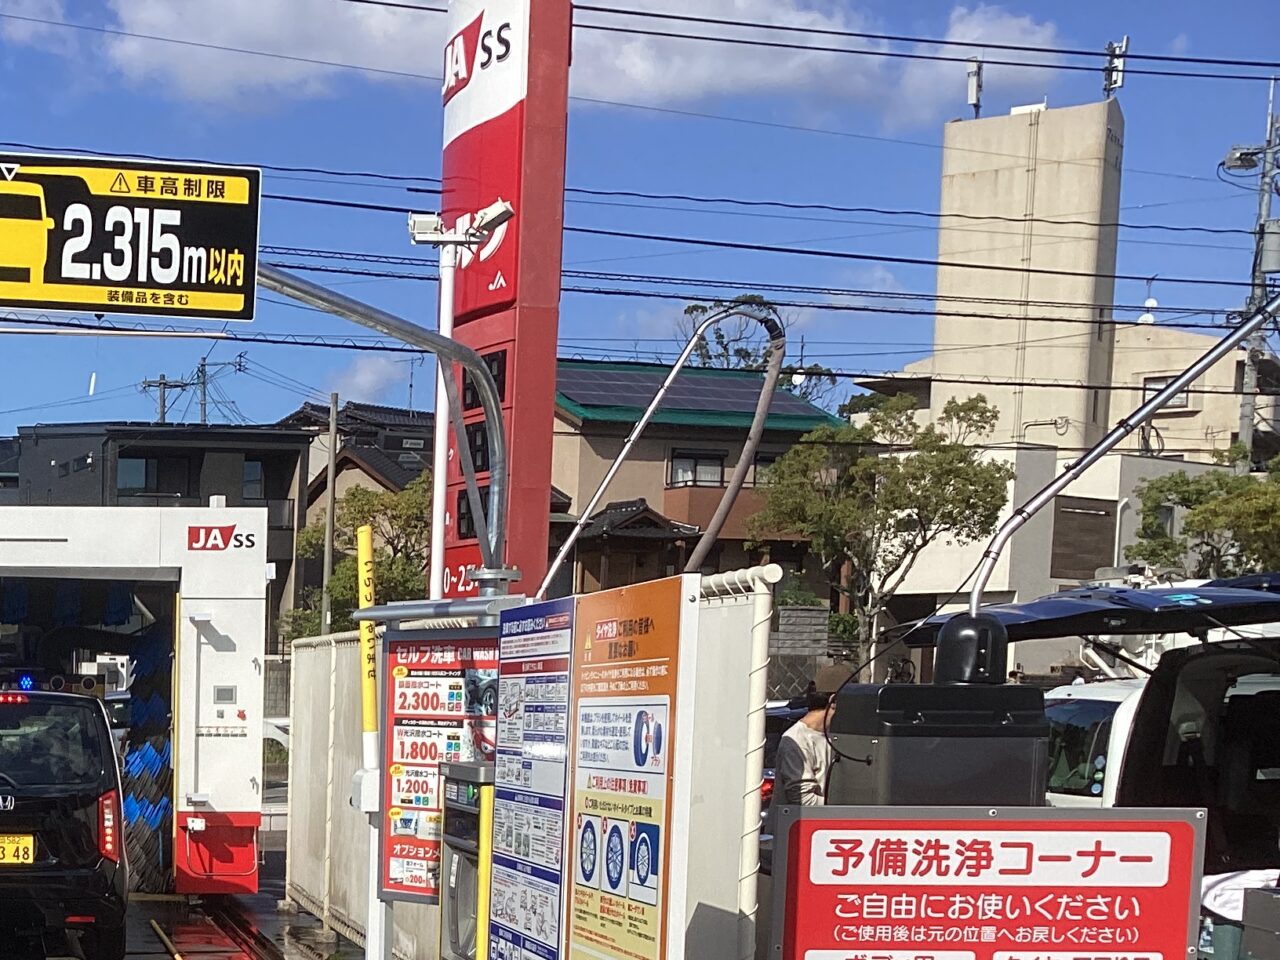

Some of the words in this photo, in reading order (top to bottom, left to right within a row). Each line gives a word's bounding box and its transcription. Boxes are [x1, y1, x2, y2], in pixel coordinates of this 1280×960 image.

[136, 175, 227, 200] 車高制限
[60, 202, 245, 287] 2.315m以内
[106, 289, 190, 307] 装備品を含む
[192, 527, 225, 549] JA
[396, 645, 456, 664] セルフ洗車
[398, 691, 446, 711] 2,300円
[399, 740, 444, 761] 1,800円
[396, 778, 434, 795] 1,200円
[825, 837, 1154, 879] 予備洗浄コーナー
[834, 893, 1141, 921] ご自由にお使いください
[832, 924, 1141, 944] (ご使用後は元の位置へお戻しください)
